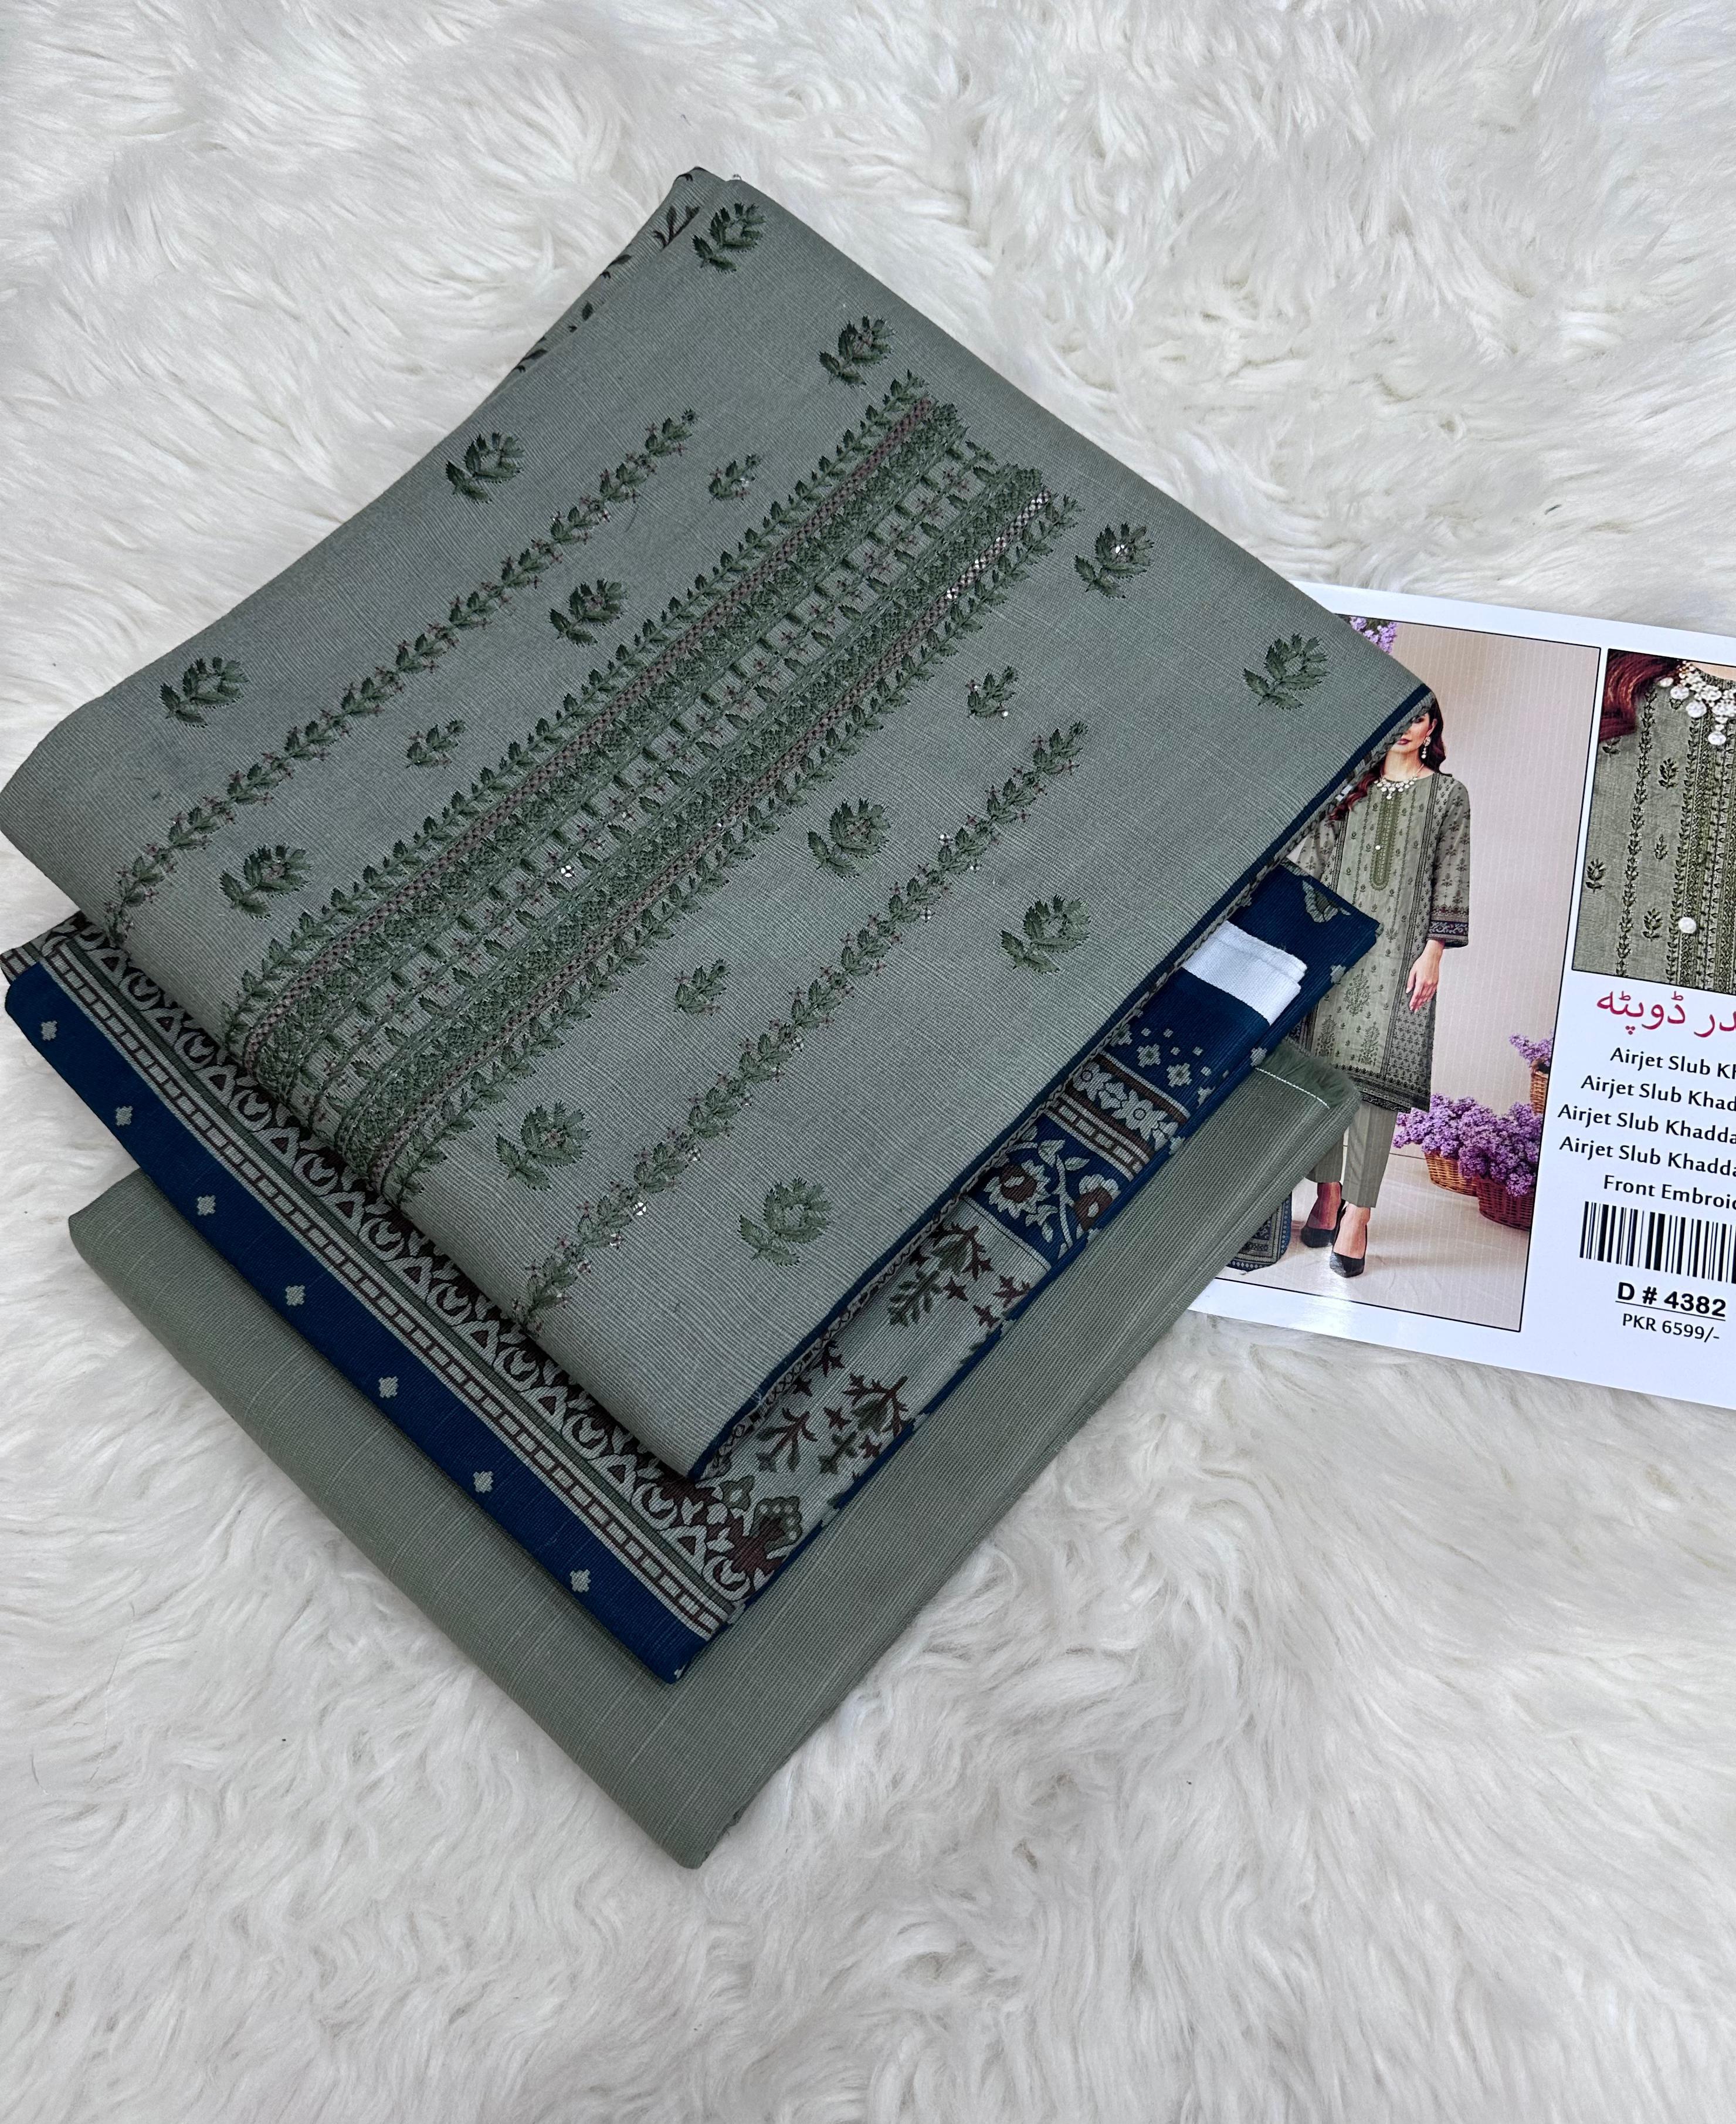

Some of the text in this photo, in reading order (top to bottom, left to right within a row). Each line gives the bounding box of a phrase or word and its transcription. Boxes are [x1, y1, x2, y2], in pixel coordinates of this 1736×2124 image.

[1596, 990, 1686, 1036] ڈوپٹہ
[1609, 1047, 1664, 1071] Airjet
[1668, 1055, 1711, 1075] Slub
[1581, 1075, 1635, 1099] Airjet
[1639, 1083, 1682, 1103] Slub
[1557, 1104, 1612, 1128] Airjet
[1616, 1112, 1659, 1132] Slub
[1559, 1136, 1614, 1161] Airjet
[1618, 1144, 1661, 1165] Slub
[1603, 1174, 1656, 1197] Front
[1618, 1282, 1726, 1317] D # 4382
[1622, 1313, 1720, 1343] PKR 6599/-
